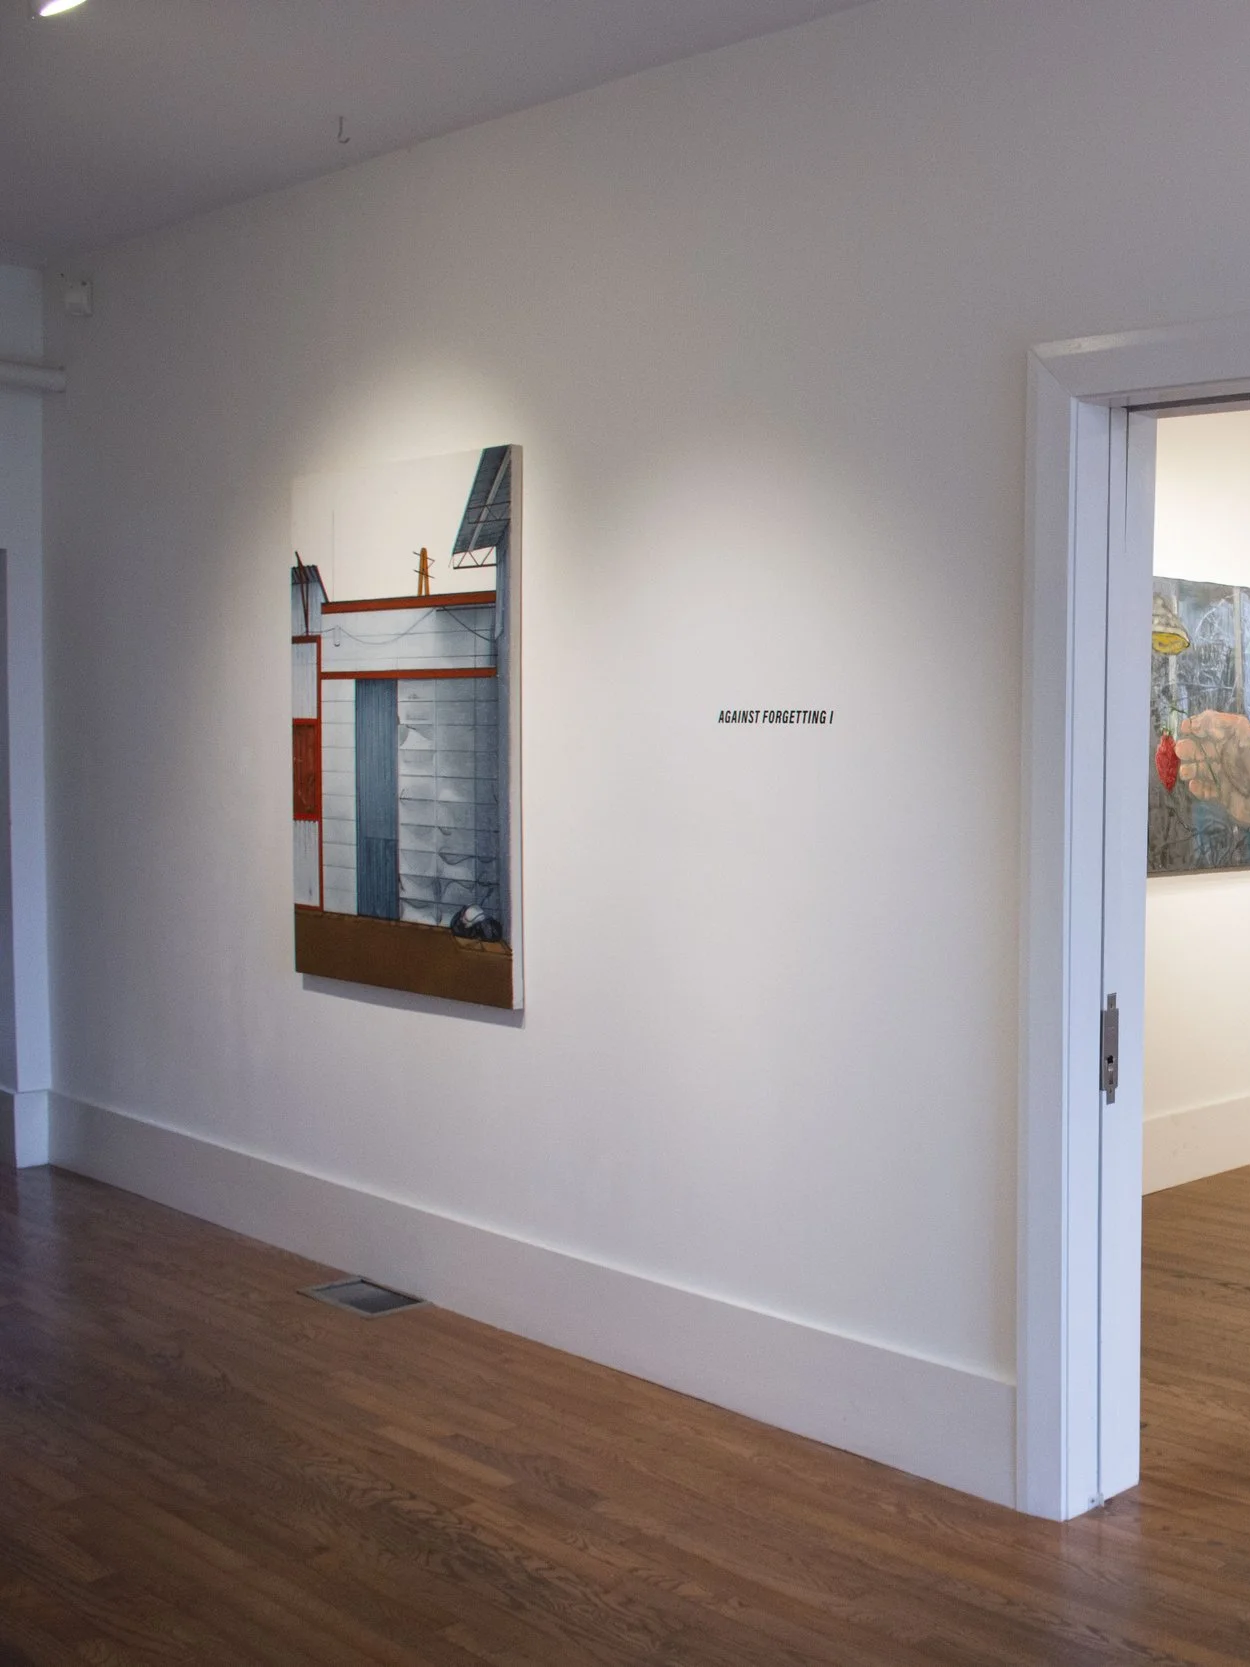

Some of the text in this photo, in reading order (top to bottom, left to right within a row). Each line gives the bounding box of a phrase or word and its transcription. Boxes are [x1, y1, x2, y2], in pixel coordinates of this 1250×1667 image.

[718, 709, 835, 725] AGAINST FORGETTING I
